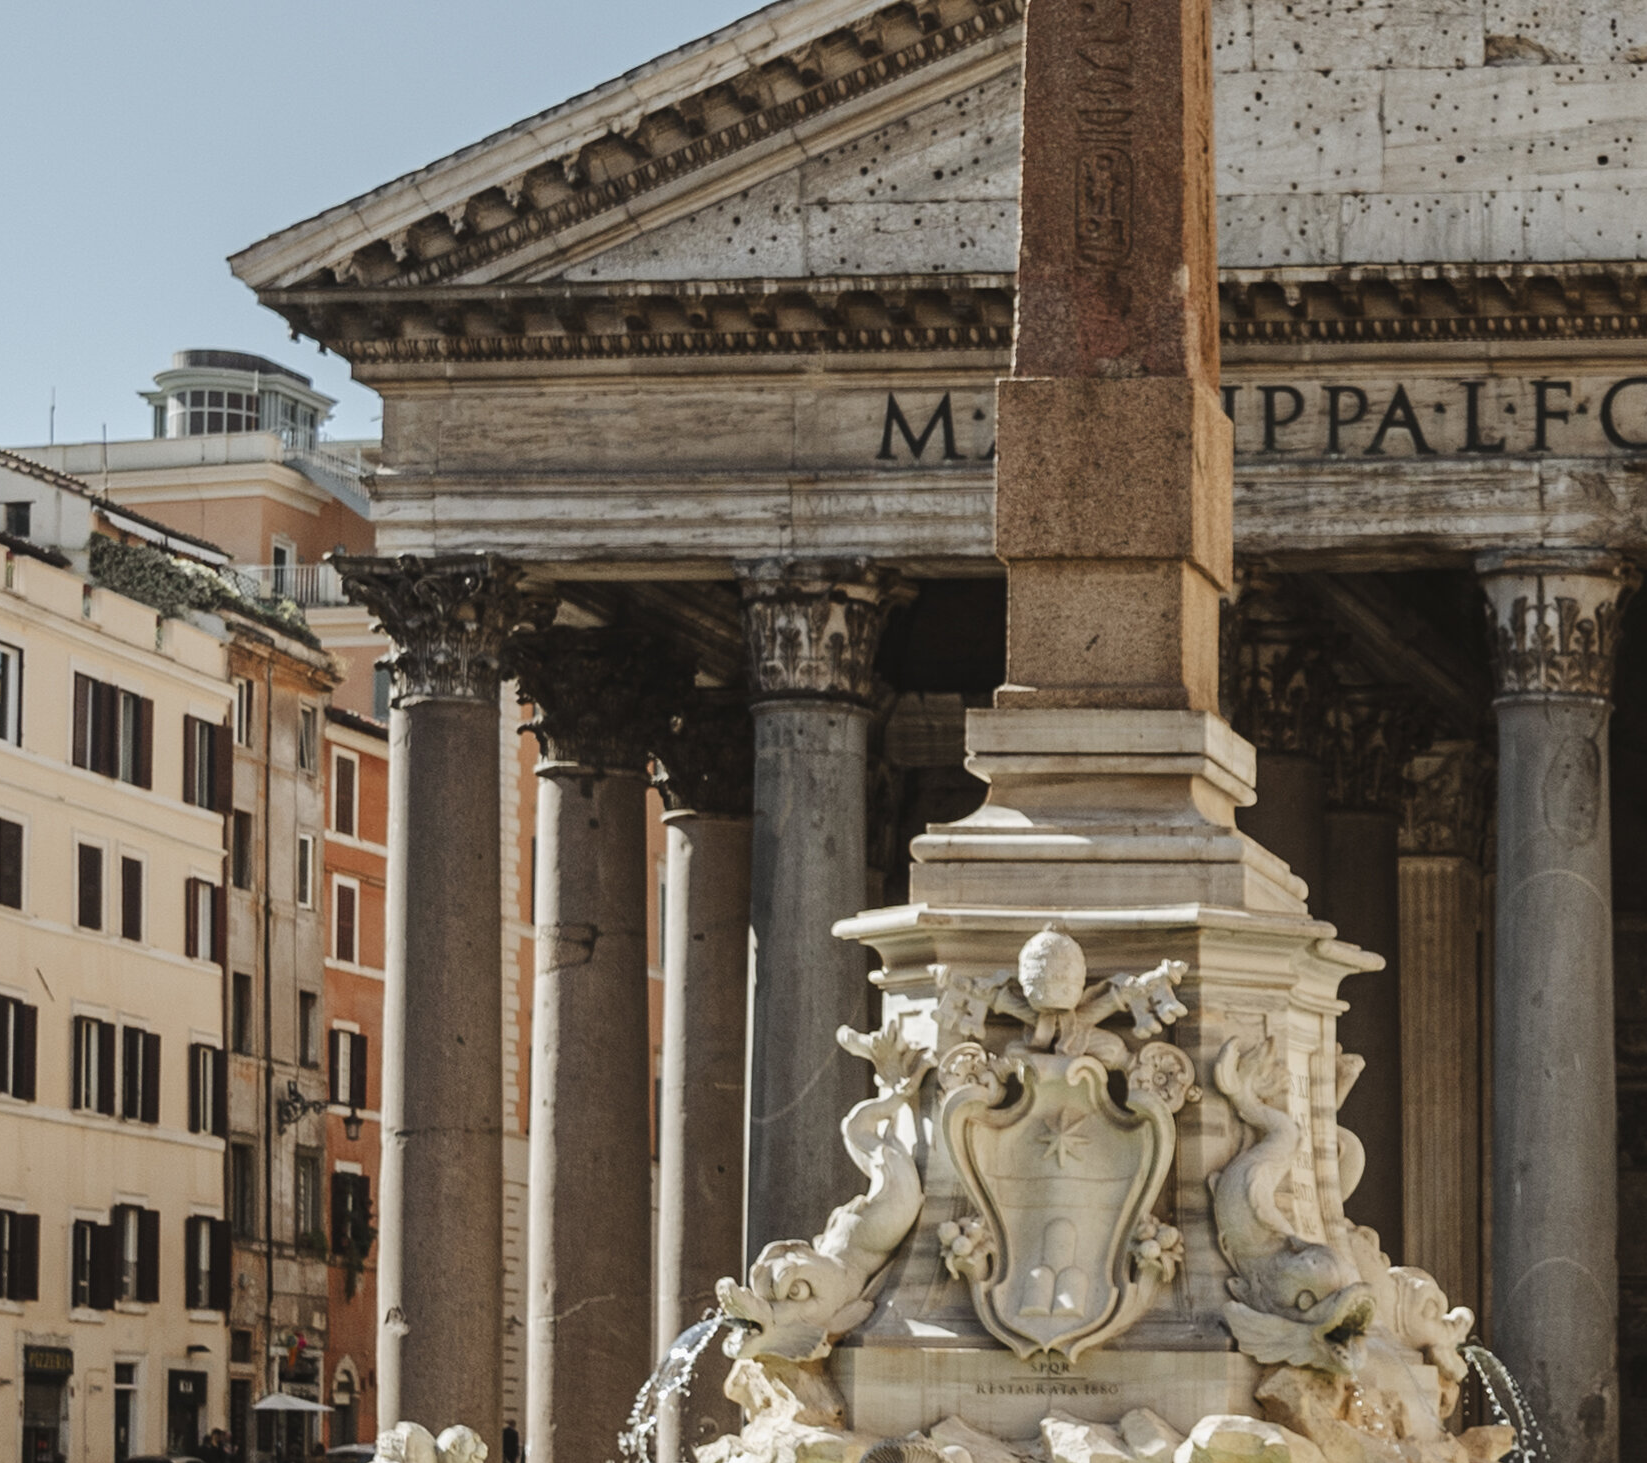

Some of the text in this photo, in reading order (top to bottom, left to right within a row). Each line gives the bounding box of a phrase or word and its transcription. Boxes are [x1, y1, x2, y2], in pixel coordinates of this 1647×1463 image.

[877, 392, 965, 461] M
[1458, 381, 1505, 455] L
[1529, 379, 1572, 452] F
[1031, 1361, 1070, 1375] SPQR
[976, 1382, 1078, 1396] RESTAURATA
